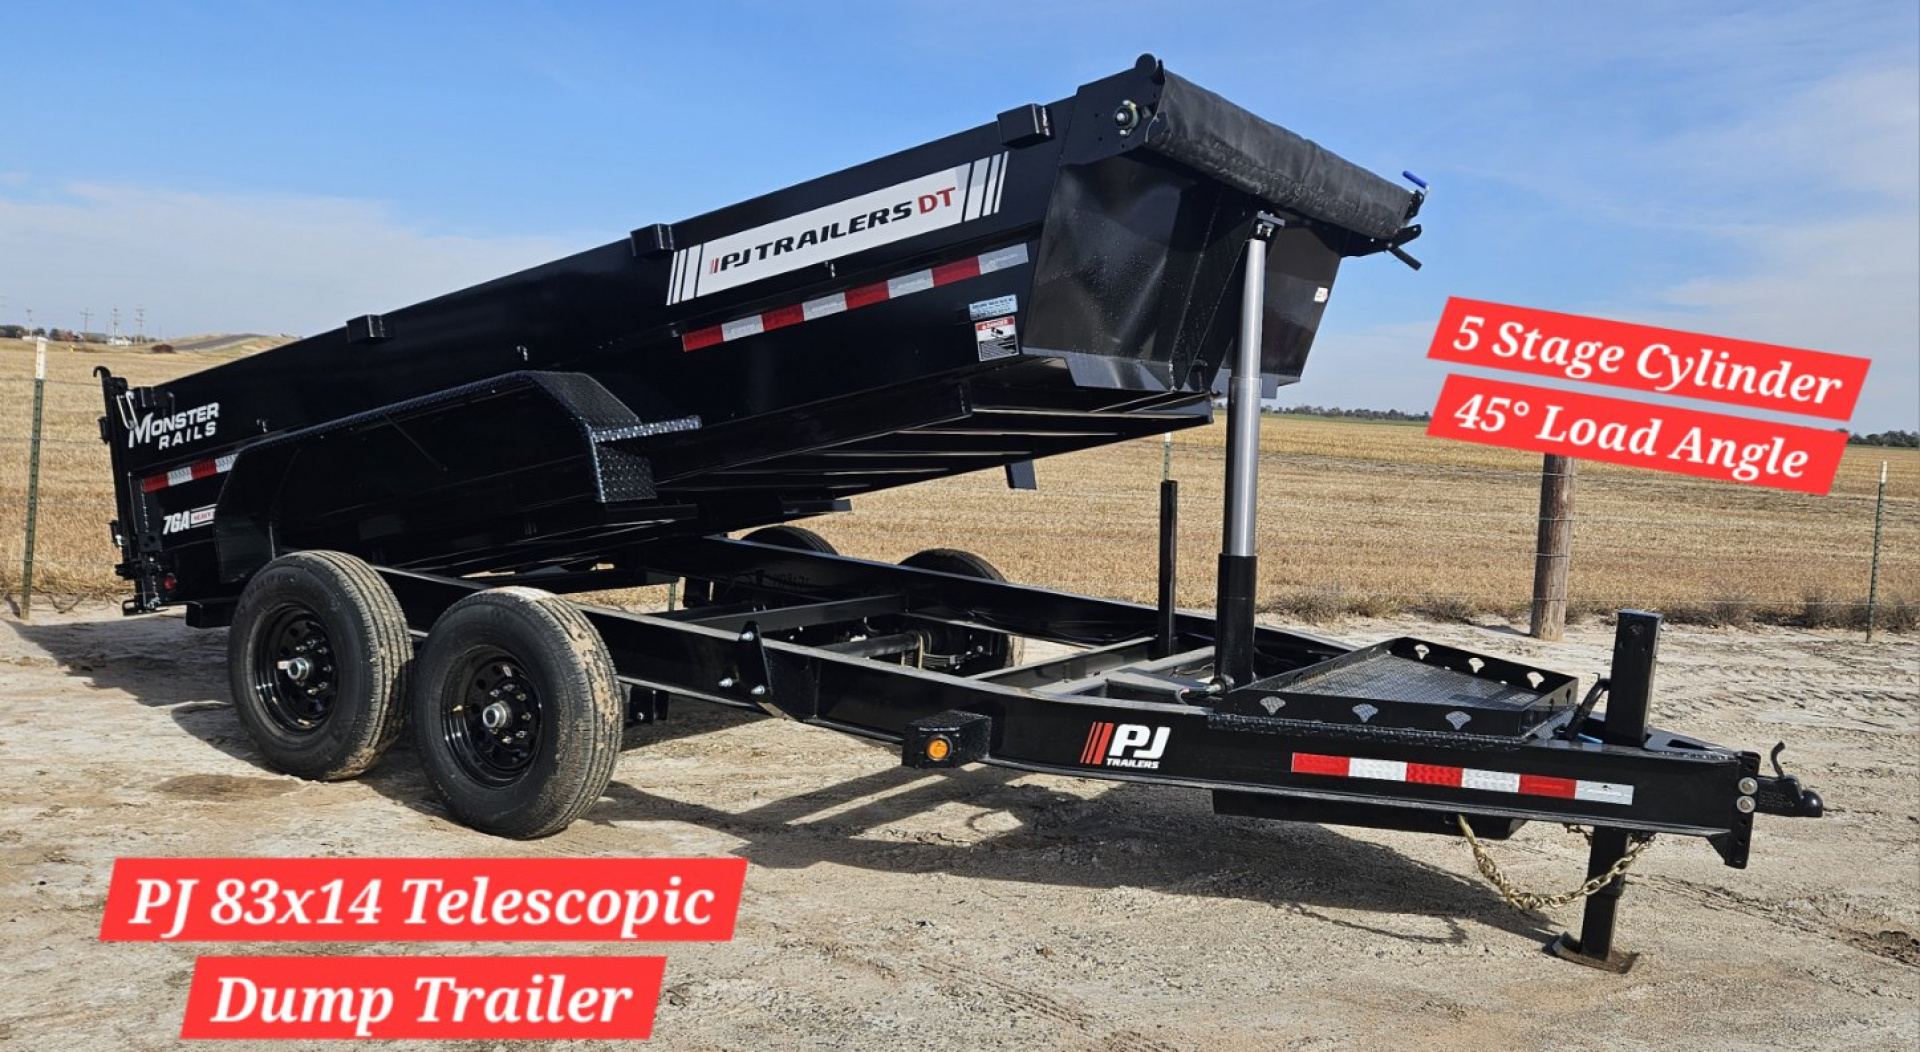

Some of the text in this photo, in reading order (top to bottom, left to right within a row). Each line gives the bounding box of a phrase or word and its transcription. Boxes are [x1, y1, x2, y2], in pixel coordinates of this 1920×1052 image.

[719, 186, 956, 272] PJ TRAILERS DT
[128, 402, 220, 448] MONSTER
[158, 421, 217, 450] RAILS
[162, 510, 191, 535] 7GA
[1108, 723, 1171, 760] PJ
[1106, 758, 1160, 769] TRAILERS
